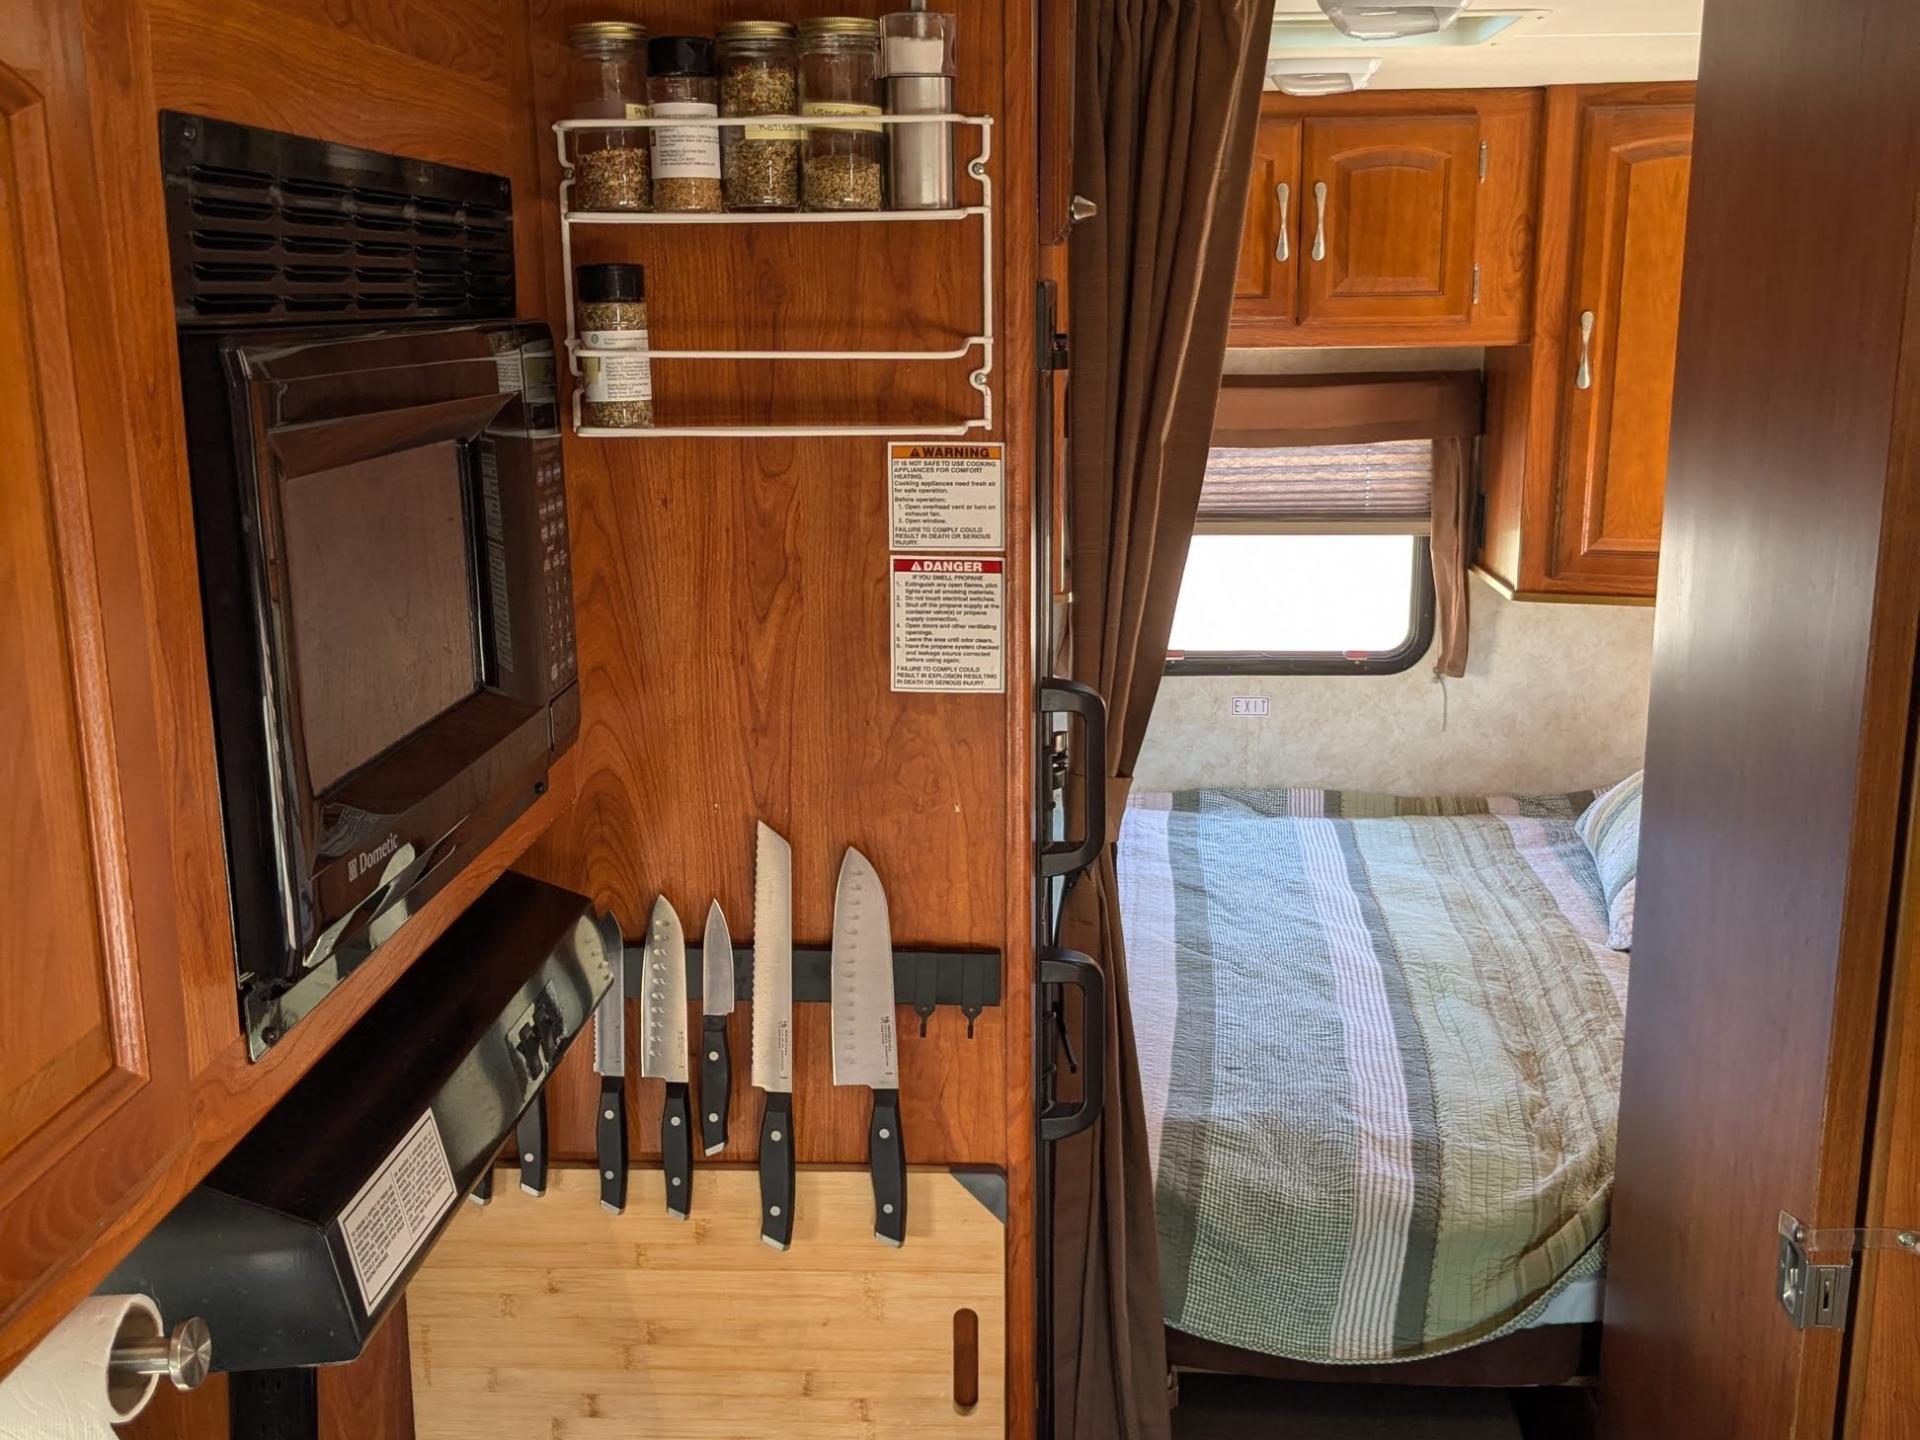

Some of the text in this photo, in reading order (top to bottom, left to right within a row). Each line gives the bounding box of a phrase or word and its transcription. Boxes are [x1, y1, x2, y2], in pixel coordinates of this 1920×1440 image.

[923, 448, 989, 458] WARNING
[923, 562, 982, 572] DANGER
[1234, 700, 1266, 712] EXIT
[360, 832, 398, 874] Dometic
